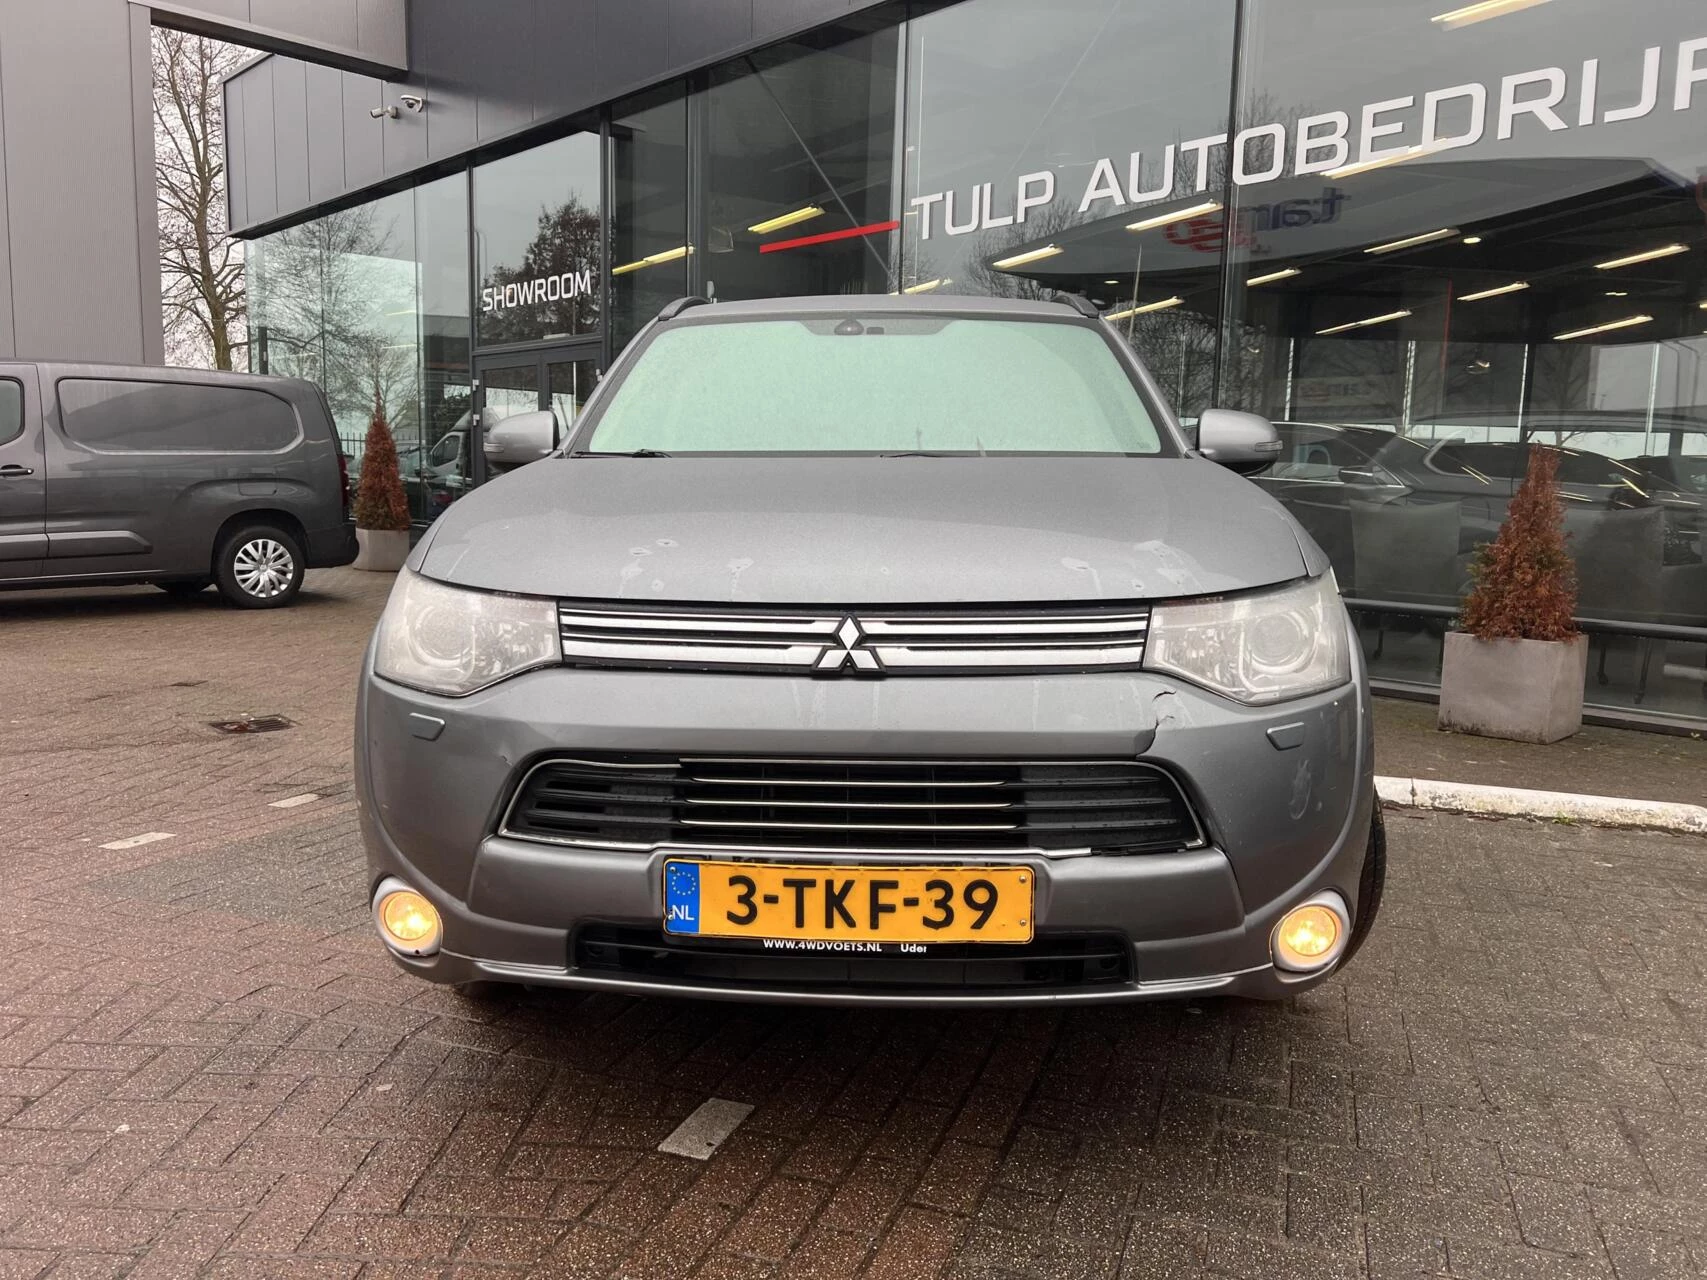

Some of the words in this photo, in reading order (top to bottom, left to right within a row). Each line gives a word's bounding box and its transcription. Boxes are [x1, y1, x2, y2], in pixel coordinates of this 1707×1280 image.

[911, 170, 1056, 240] TULP
[482, 270, 592, 311] SHOWROOM
[672, 904, 694, 921] NL
[726, 875, 999, 930] 3-TKF-39
[763, 939, 883, 953] WWW.4WDVOETS.NL
